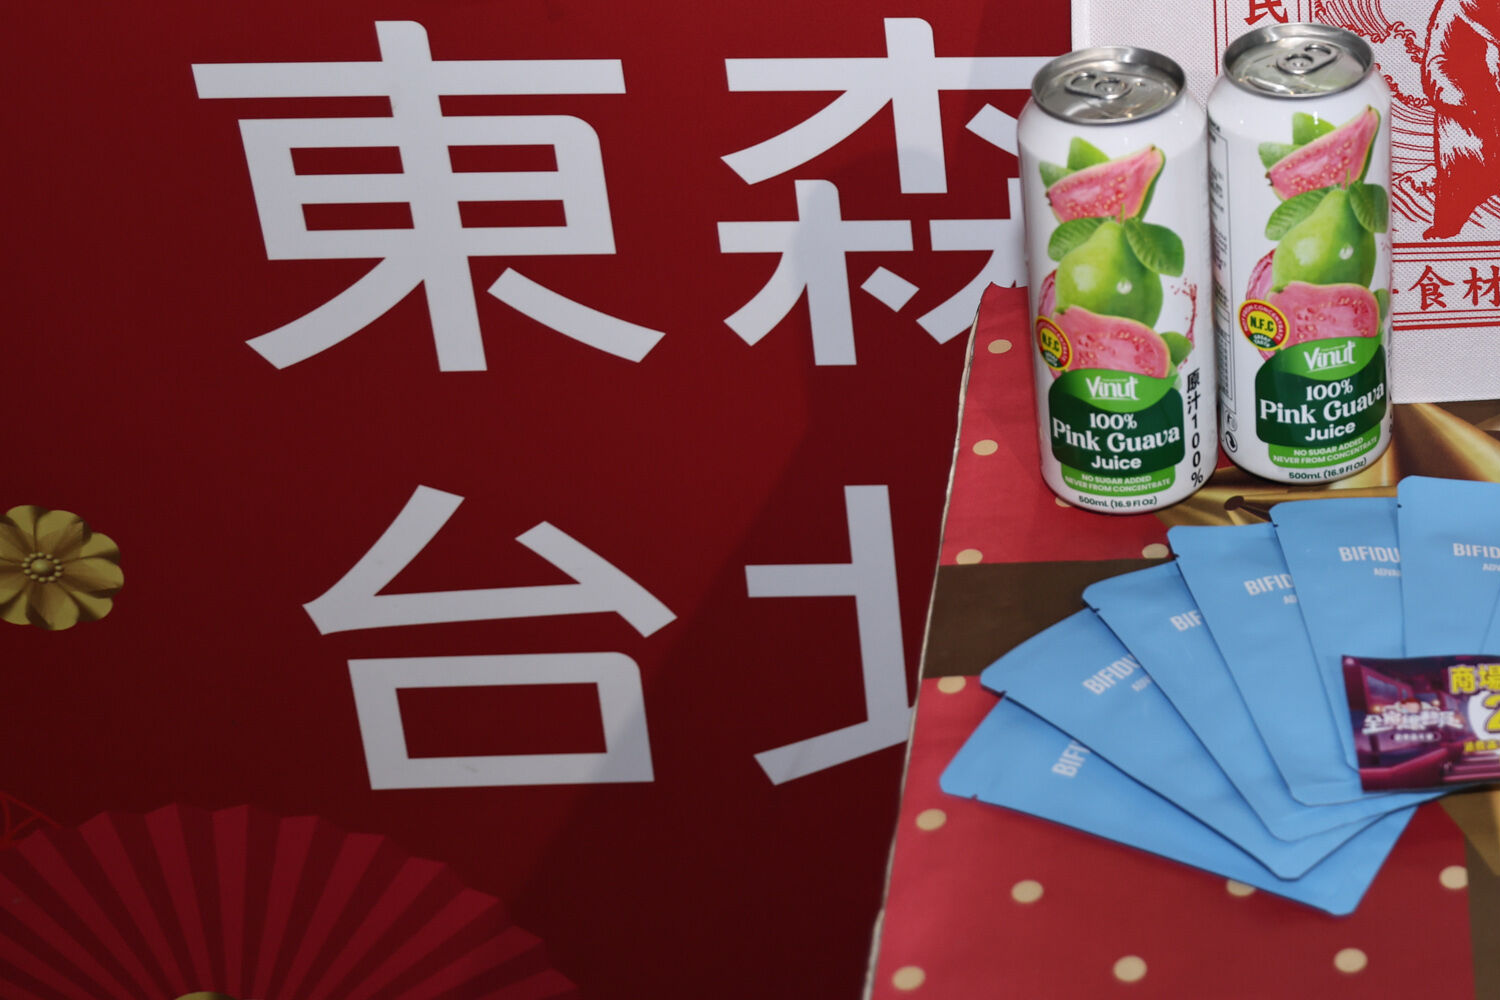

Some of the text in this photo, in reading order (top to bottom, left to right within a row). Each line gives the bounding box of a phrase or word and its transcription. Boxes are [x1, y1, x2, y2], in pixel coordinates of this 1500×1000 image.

[1304, 340, 1356, 372] Vinut
[1085, 375, 1139, 400] Vinut
[1305, 379, 1354, 402] 100%
[1260, 398, 1317, 425] Pink
[1323, 382, 1384, 422] Guava
[1089, 412, 1138, 430] 100%
[1186, 367, 1204, 488] 原汁100%
[1305, 421, 1356, 442] Juice
[1052, 417, 1180, 453] Pink Guava
[1293, 437, 1364, 456] NO SUGAR ADDED
[1091, 456, 1142, 470] Juice
[1273, 454, 1300, 464] NEVER
[1300, 456, 1325, 464] FROM
[1081, 473, 1152, 485] NO SUGAR ADDED
[1088, 482, 1112, 491] FROM
